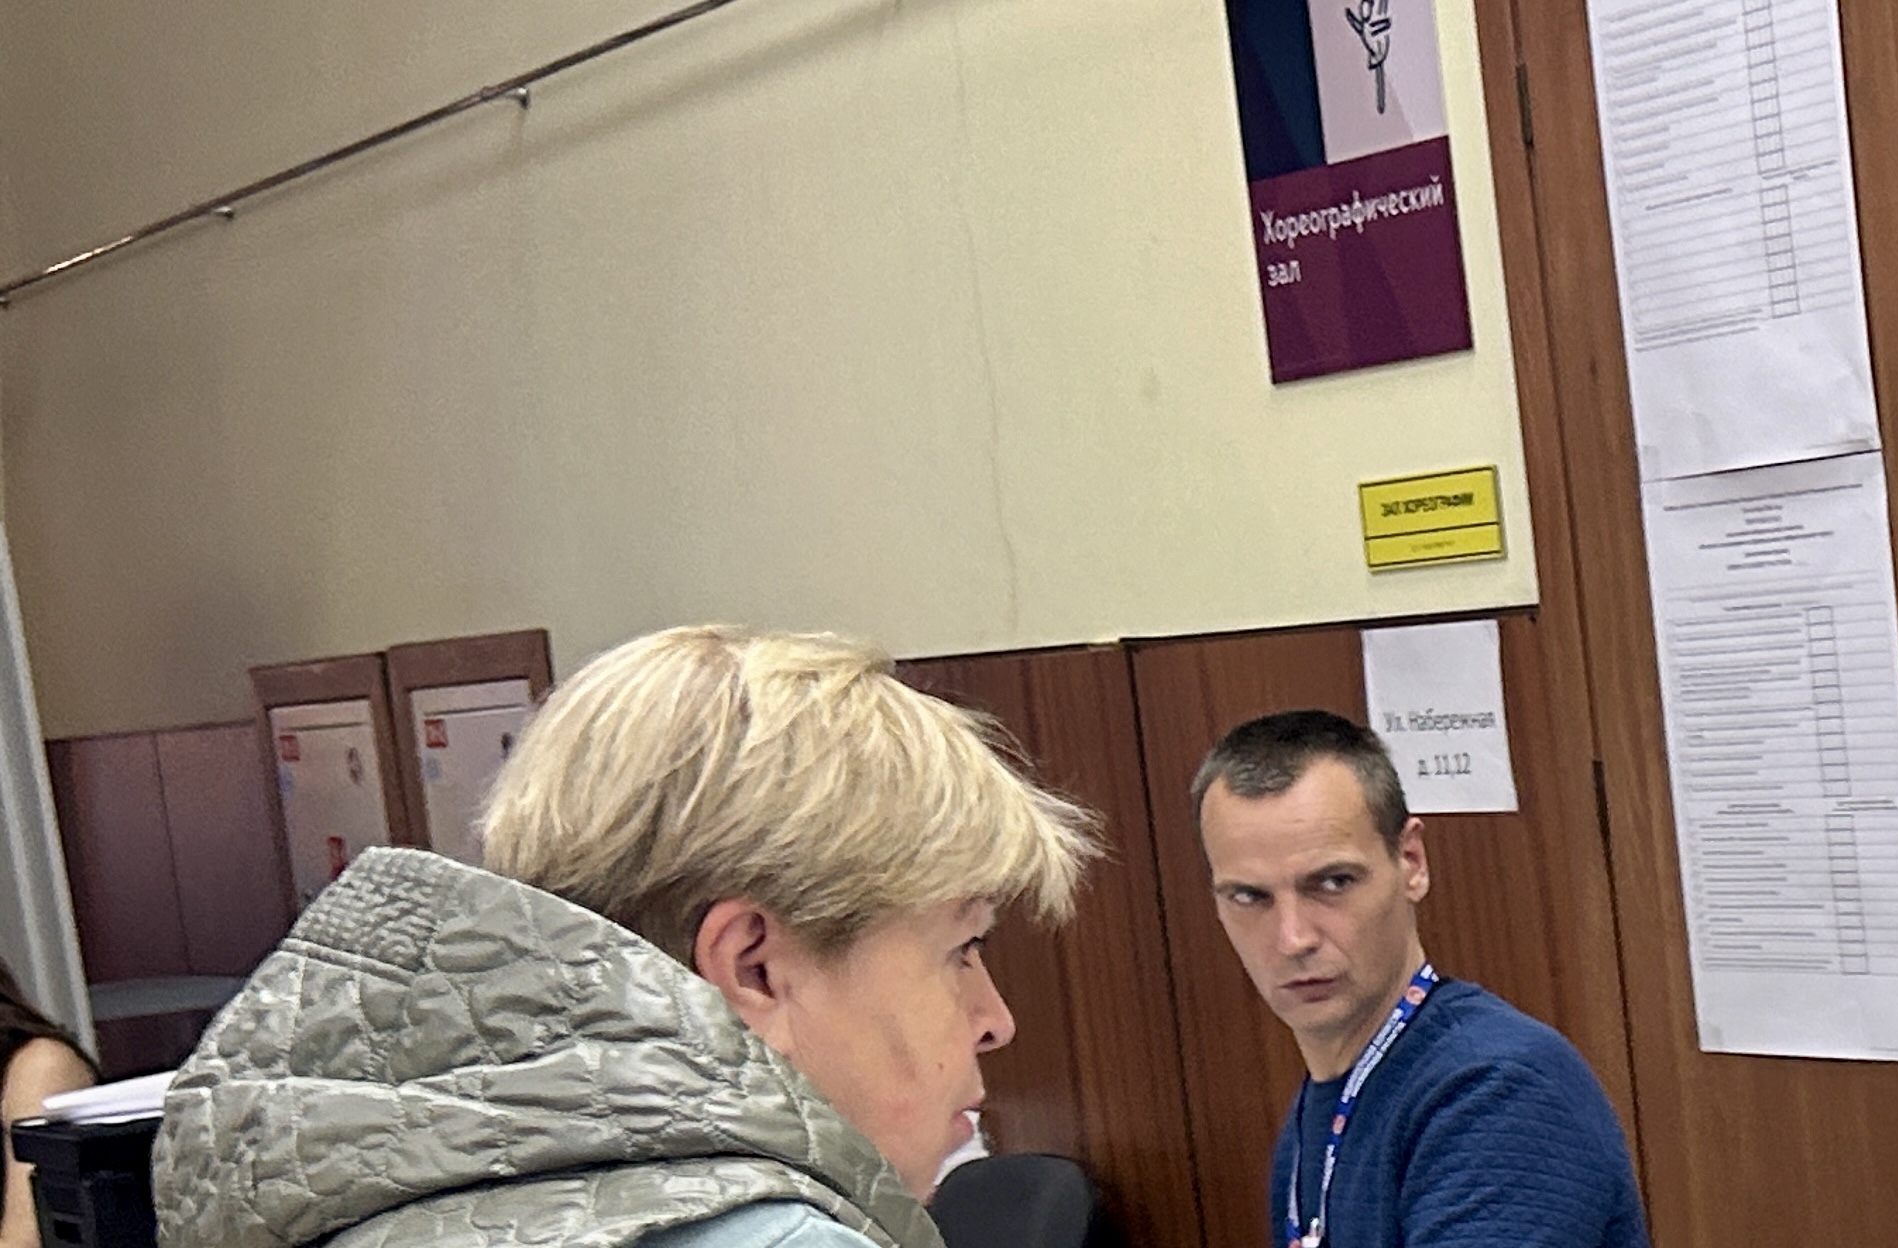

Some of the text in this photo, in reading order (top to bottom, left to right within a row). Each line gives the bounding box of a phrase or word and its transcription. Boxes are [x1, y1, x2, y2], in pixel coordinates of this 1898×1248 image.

[1259, 175, 1444, 249] Хореографический
[1267, 260, 1301, 286] зал
[1409, 708, 1496, 735] Набережная
